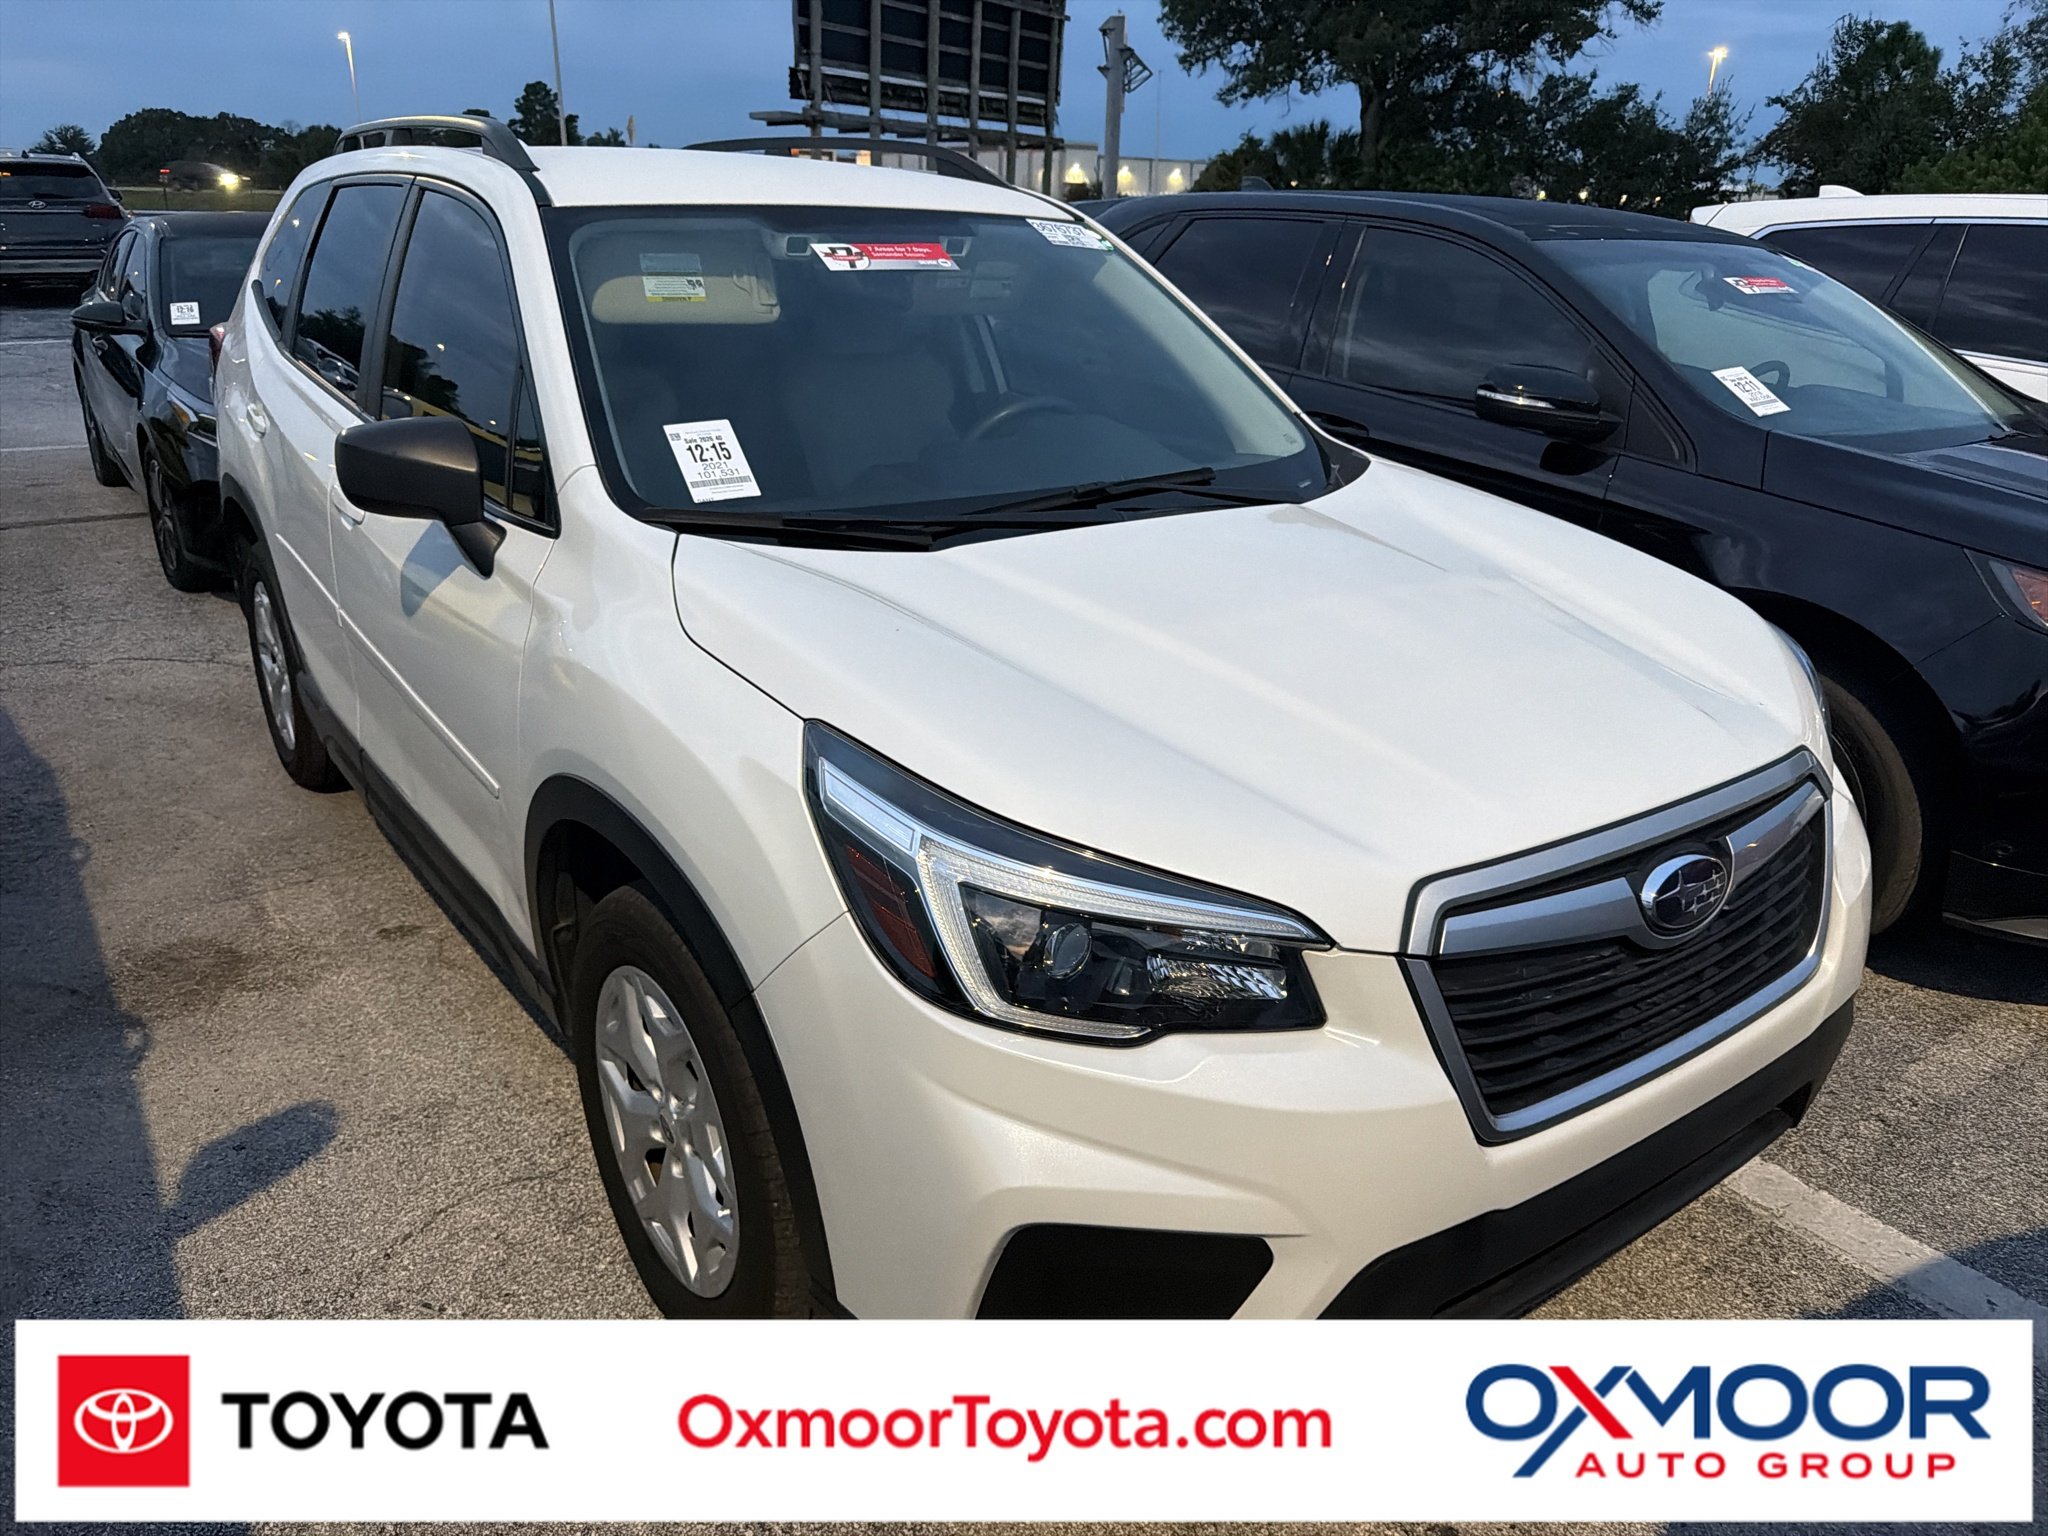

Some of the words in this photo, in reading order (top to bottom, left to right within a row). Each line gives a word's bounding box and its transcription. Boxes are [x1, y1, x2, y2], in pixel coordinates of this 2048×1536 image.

[684, 437, 698, 445] Sale
[686, 441, 732, 463] 12:15
[701, 461, 728, 471] 2021
[697, 468, 741, 479] 101,531
